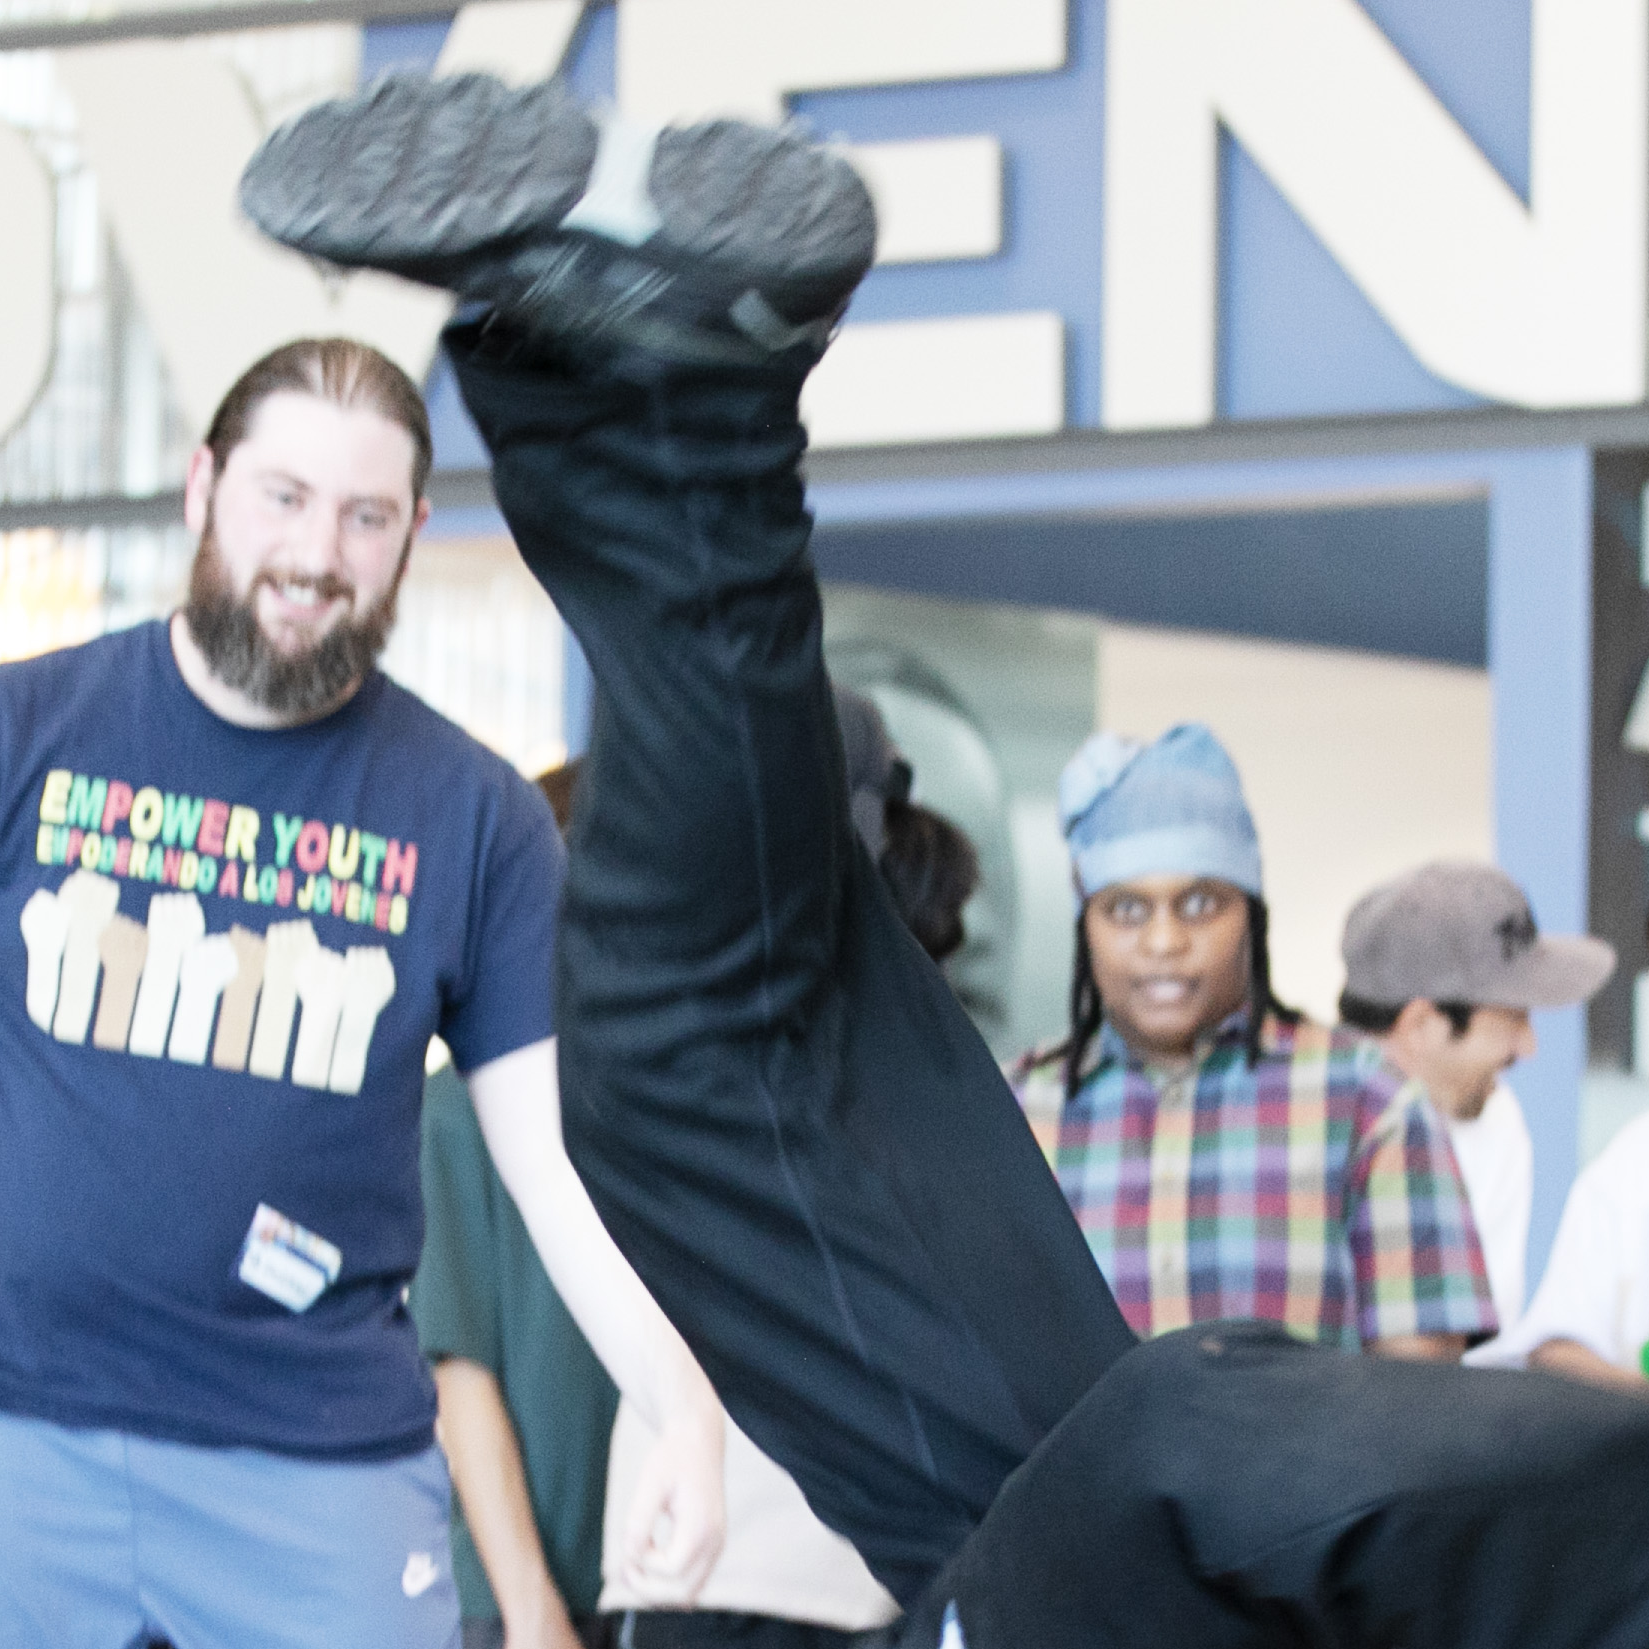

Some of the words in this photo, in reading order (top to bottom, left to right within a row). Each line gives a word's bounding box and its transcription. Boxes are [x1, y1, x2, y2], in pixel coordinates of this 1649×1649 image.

[36, 823, 218, 894] EMPODERANDO
[219, 861, 239, 898] A
[243, 865, 294, 907] LOS
[297, 875, 409, 935] JOVENES
[39, 769, 260, 862] EMPOWER
[272, 813, 418, 896] YOUTH
